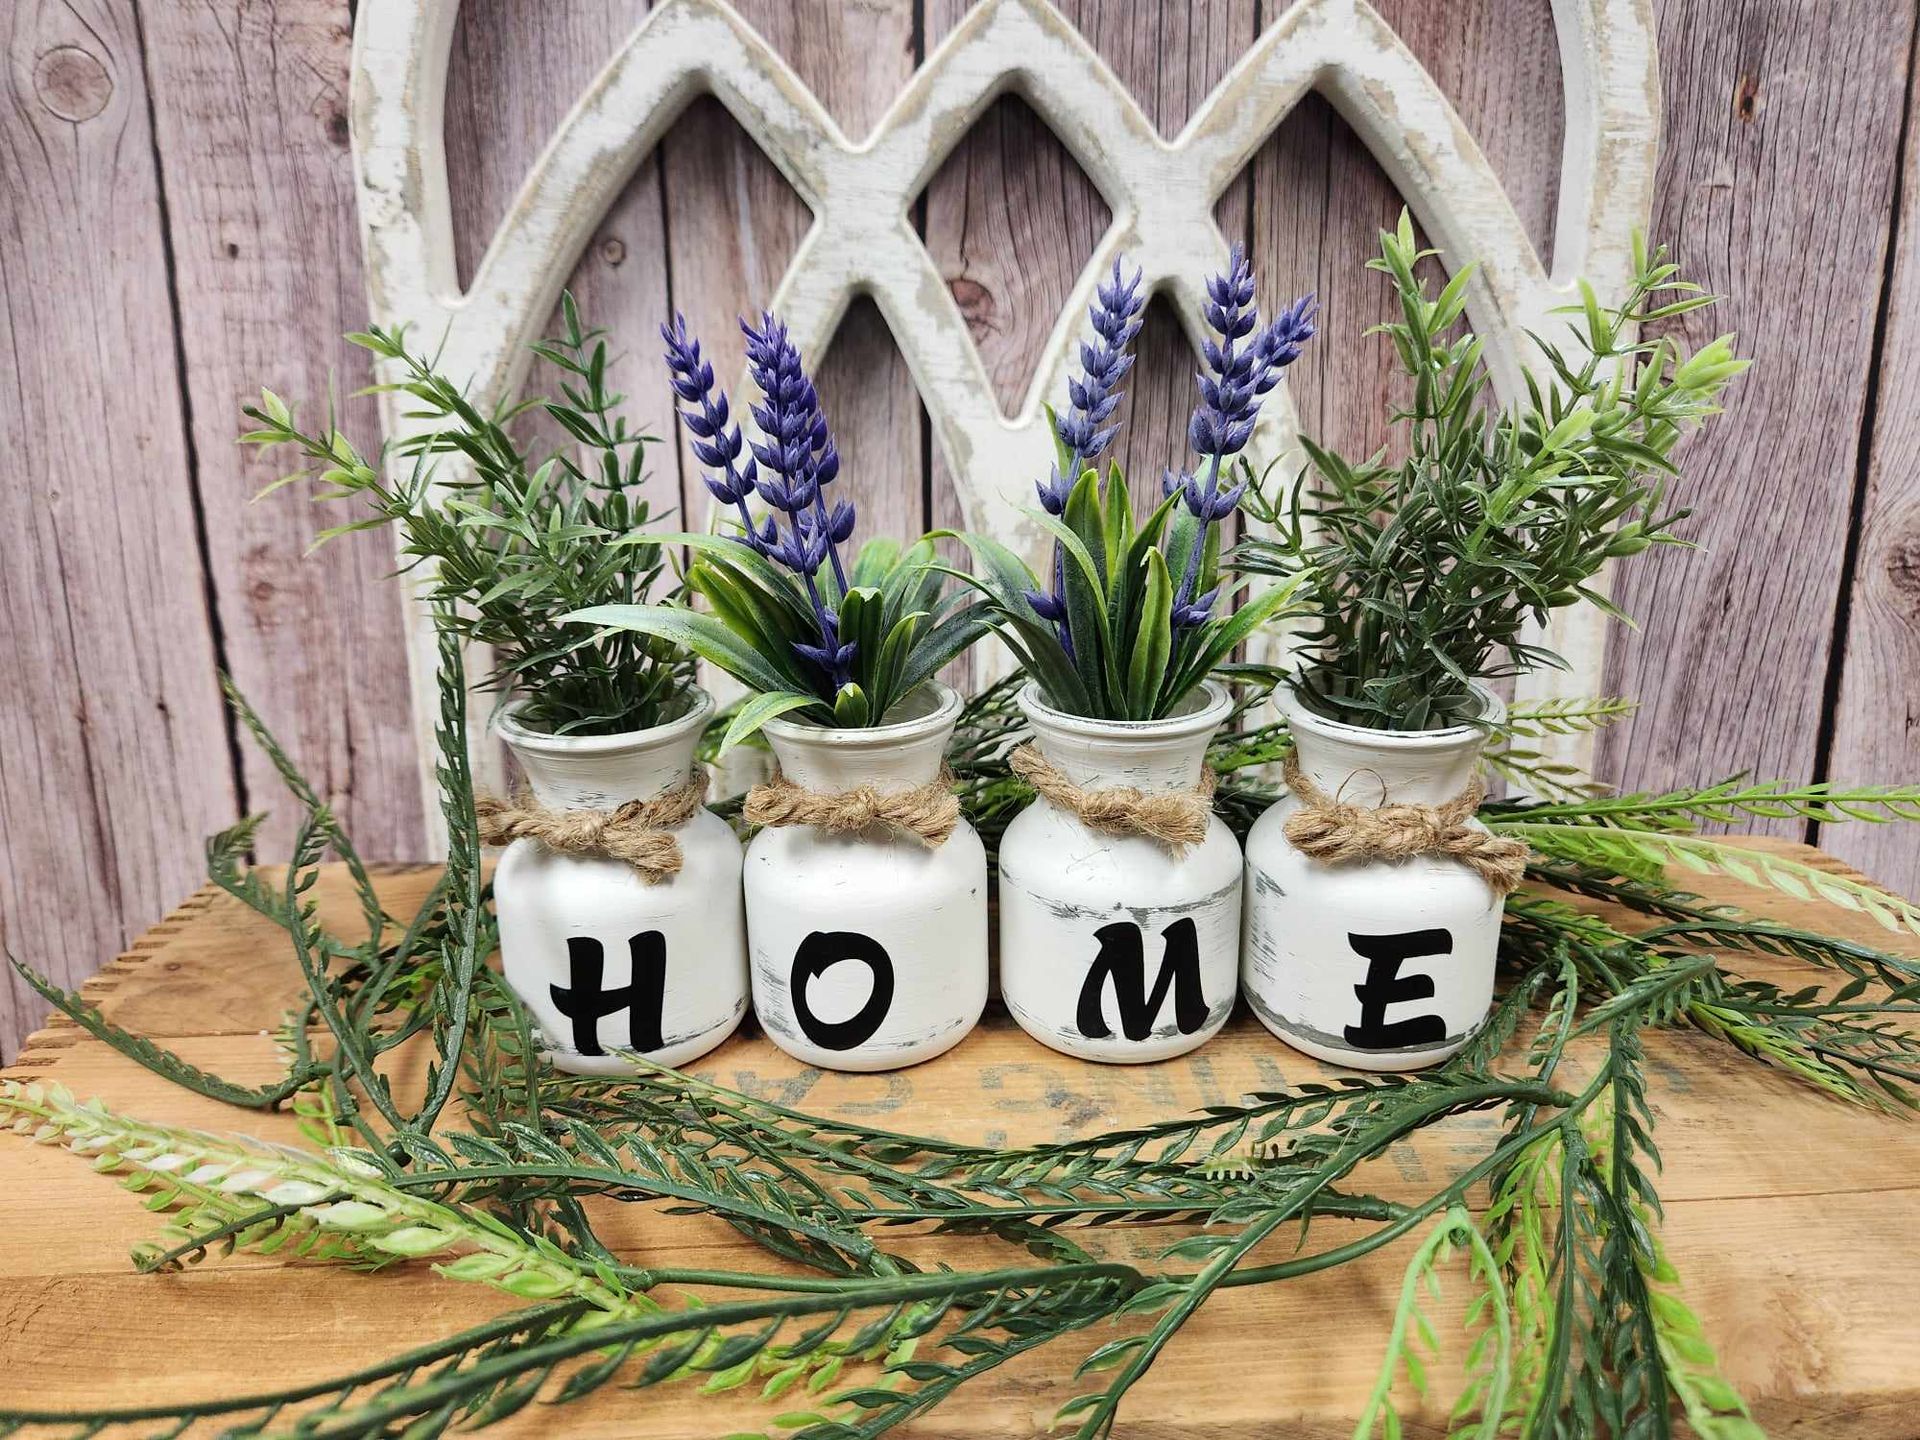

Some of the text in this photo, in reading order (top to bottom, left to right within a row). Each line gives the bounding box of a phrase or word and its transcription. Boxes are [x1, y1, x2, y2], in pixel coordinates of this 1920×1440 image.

[550, 931, 666, 1056] H
[791, 931, 894, 1051] O
[1077, 918, 1208, 1041] M
[1344, 929, 1452, 1049] E
